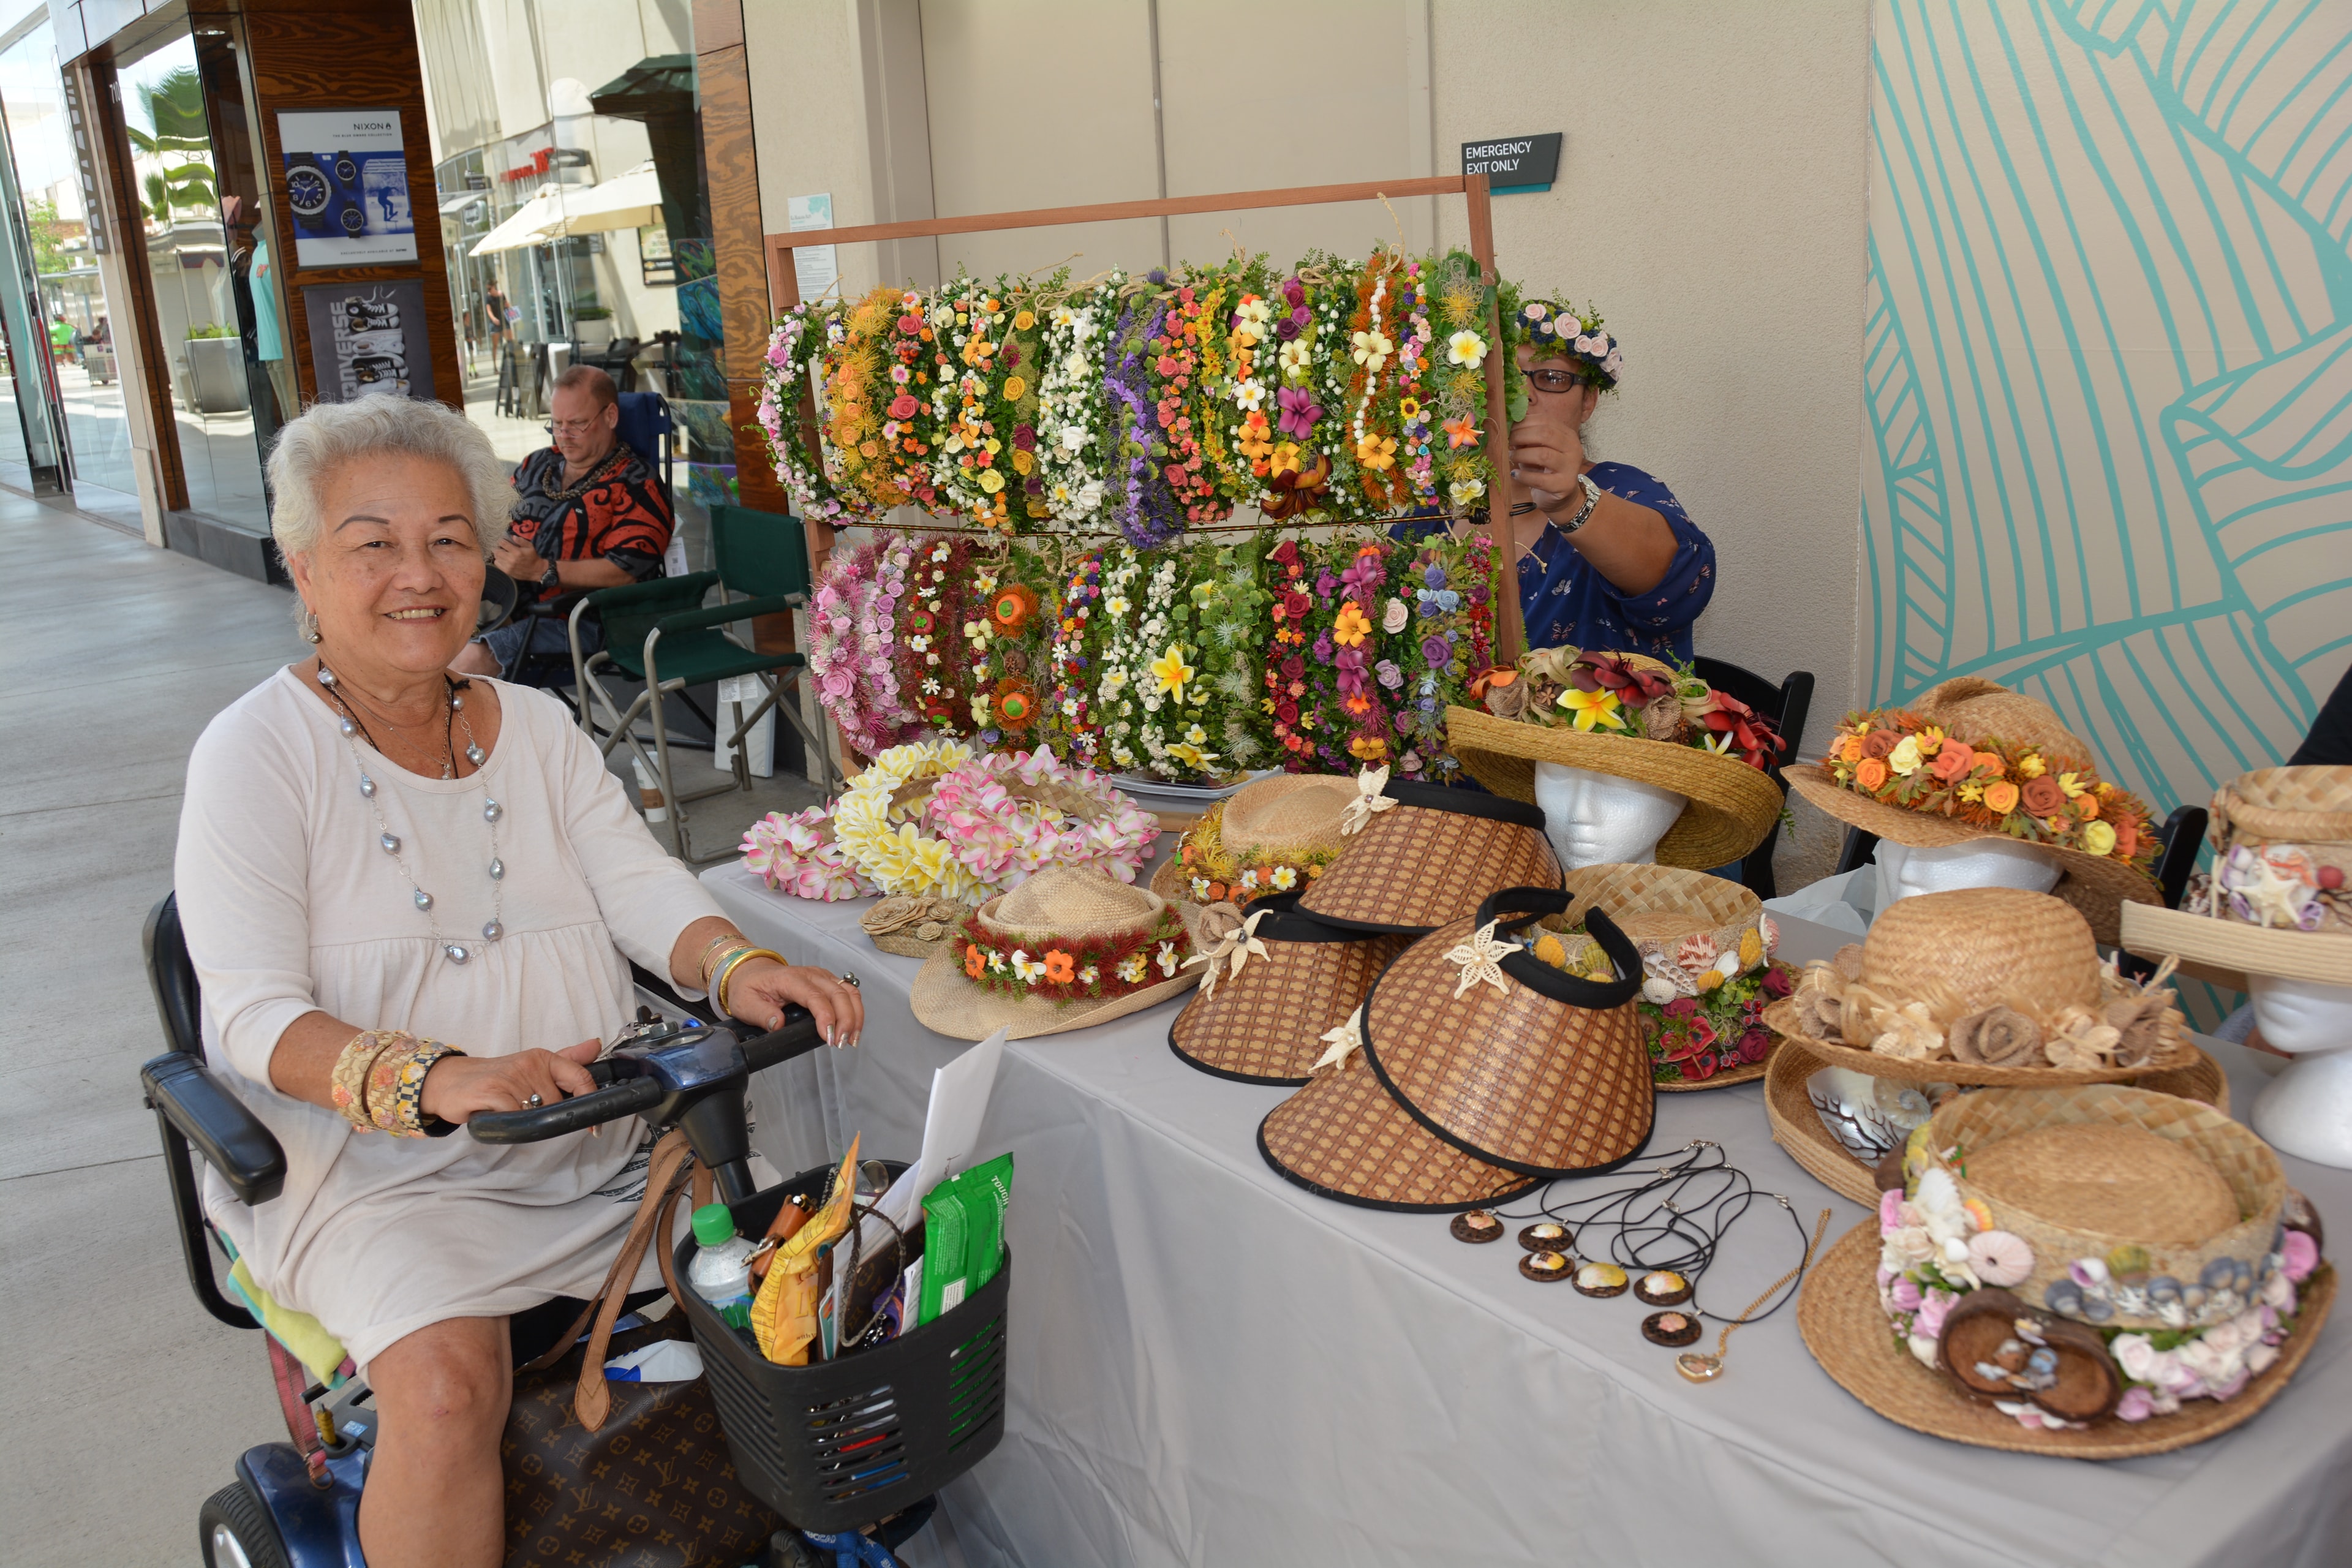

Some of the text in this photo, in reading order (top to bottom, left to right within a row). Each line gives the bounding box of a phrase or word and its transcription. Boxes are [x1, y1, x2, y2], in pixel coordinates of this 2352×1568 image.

[109, 81, 121, 104] 710
[1466, 140, 1532, 159] EMERGENCY
[1466, 158, 1520, 175] EXIT ONLY
[991, 1175, 1009, 1205] TOUGH
